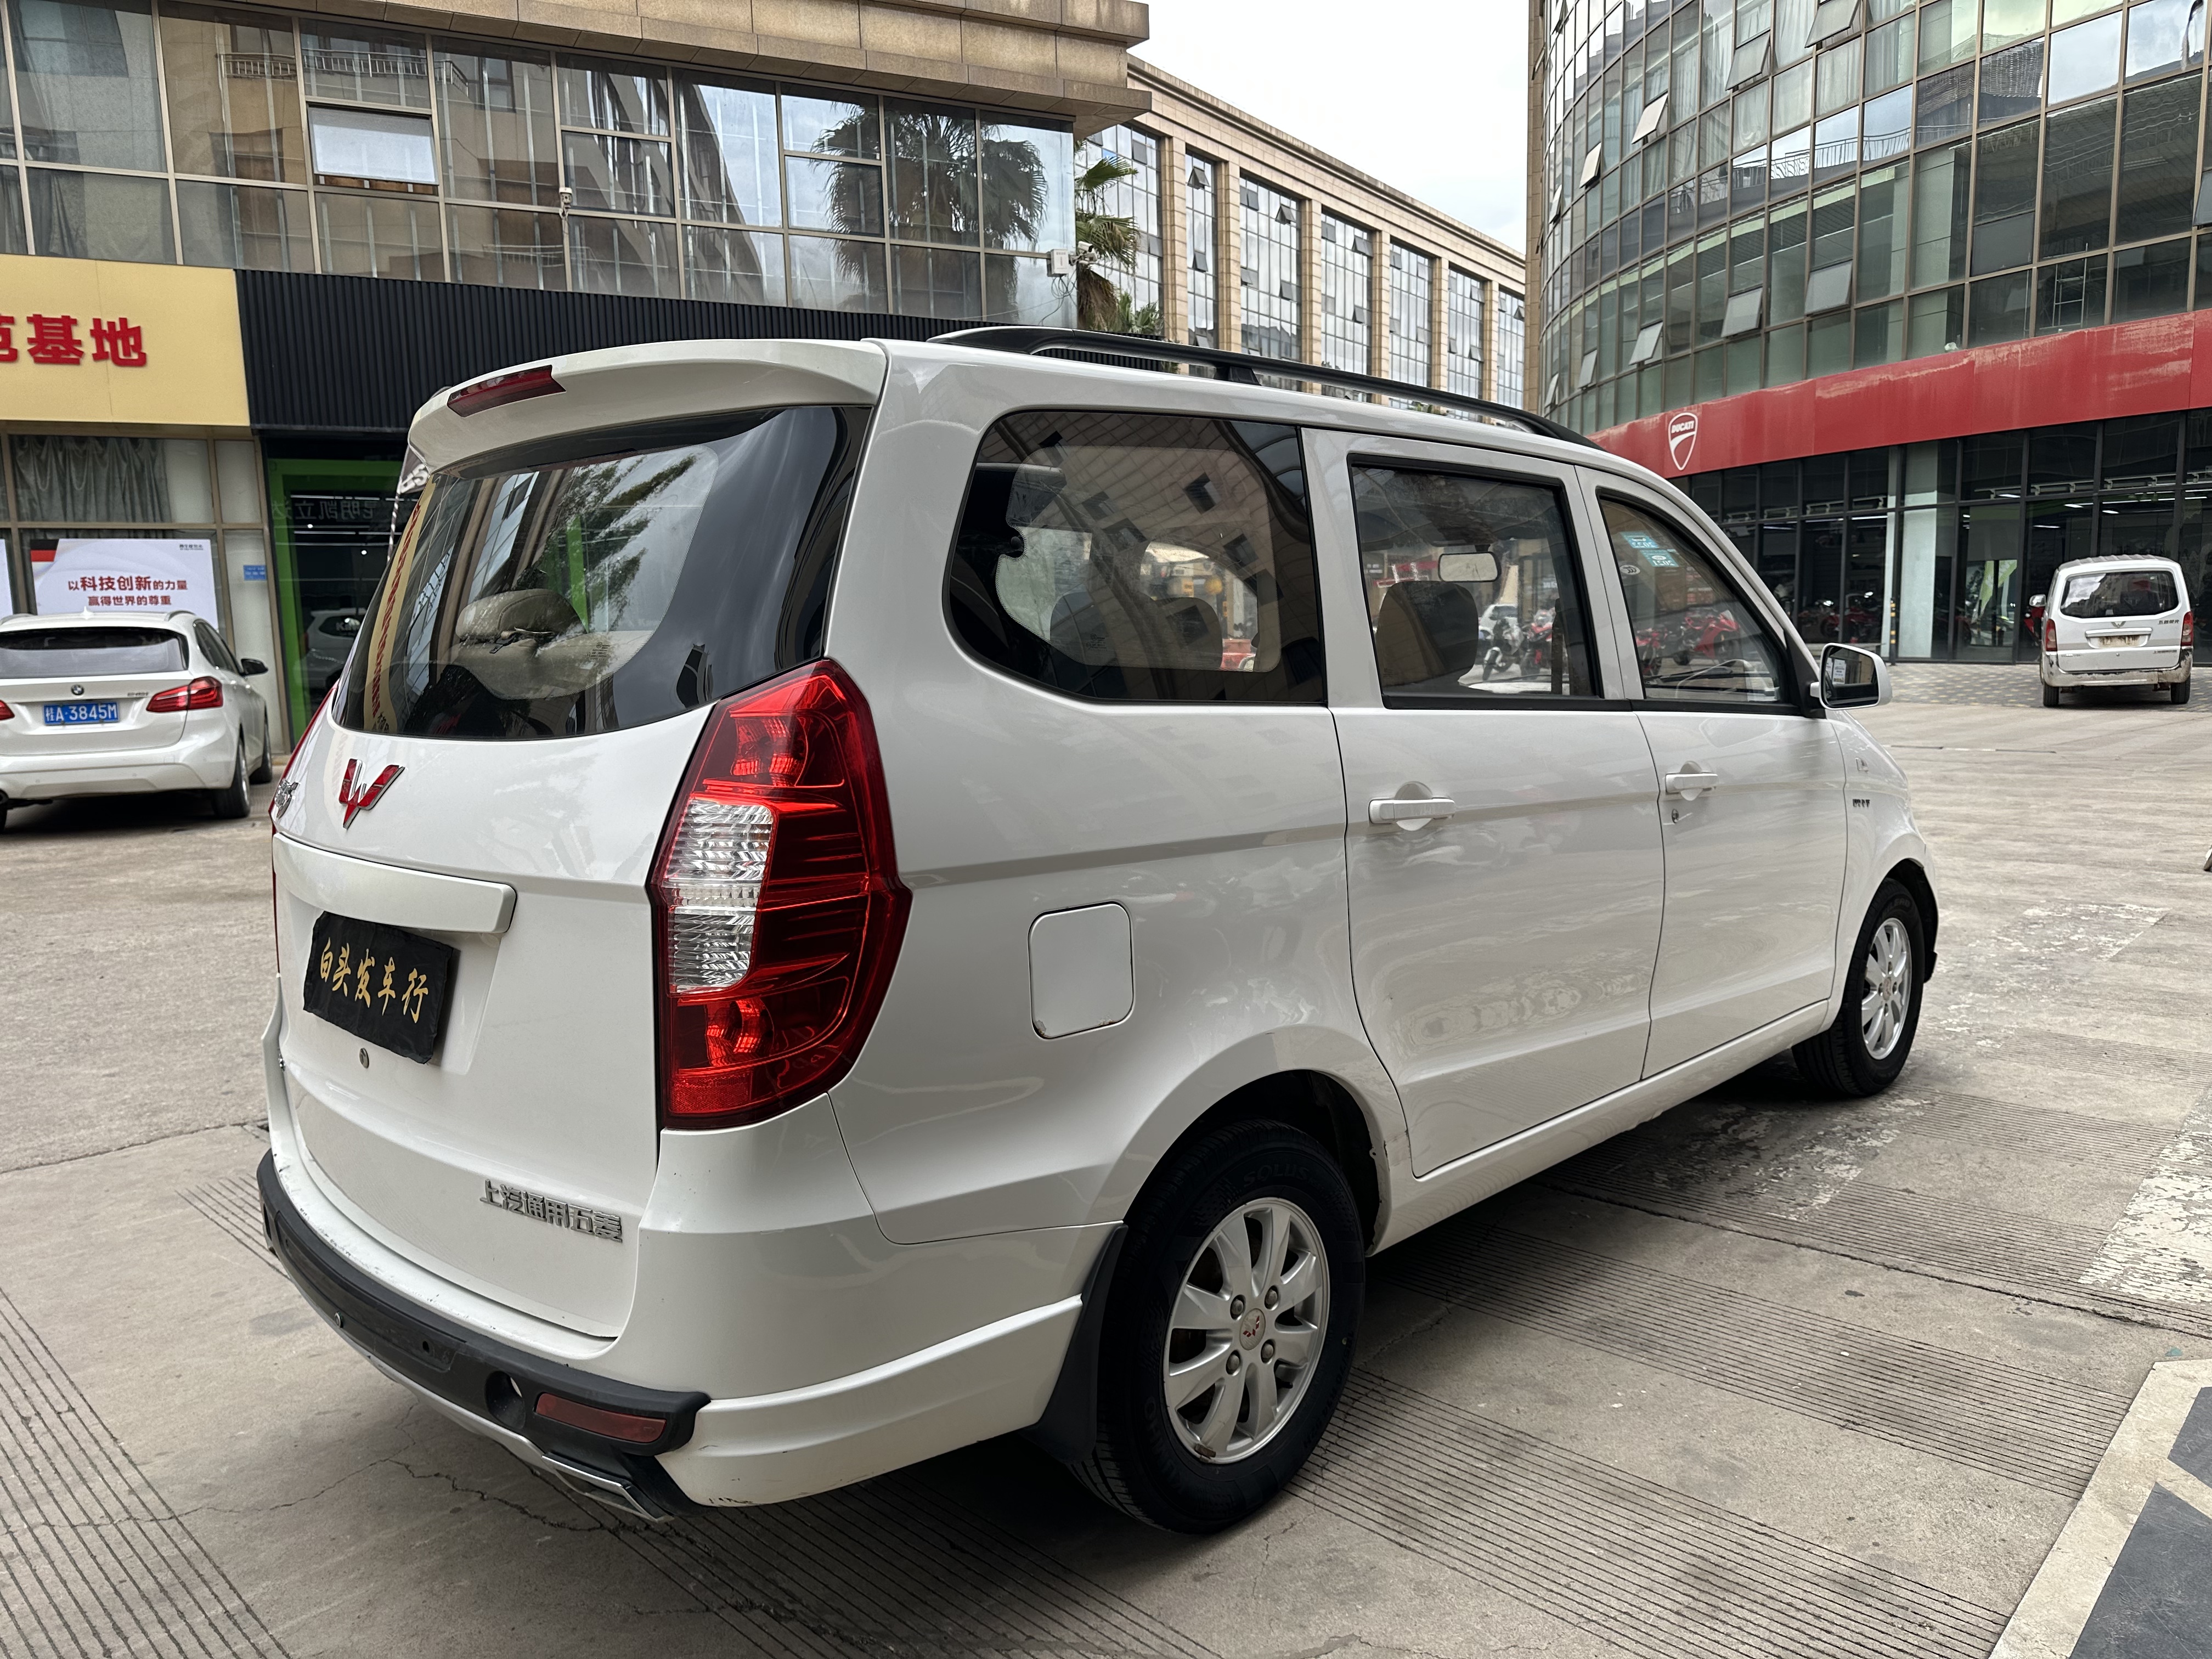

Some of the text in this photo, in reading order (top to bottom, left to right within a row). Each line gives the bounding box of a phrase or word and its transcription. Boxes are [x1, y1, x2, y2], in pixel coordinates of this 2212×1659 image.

[1671, 420, 1695, 433] DUCATI
[68, 575, 188, 591] 以科技创新的力量
[88, 595, 172, 606] 赢得世界的尊重
[320, 936, 428, 1024] 白头发车行
[1243, 1163, 1310, 1188] SOLUS
[479, 1178, 623, 1243] 上汽通用五菱
